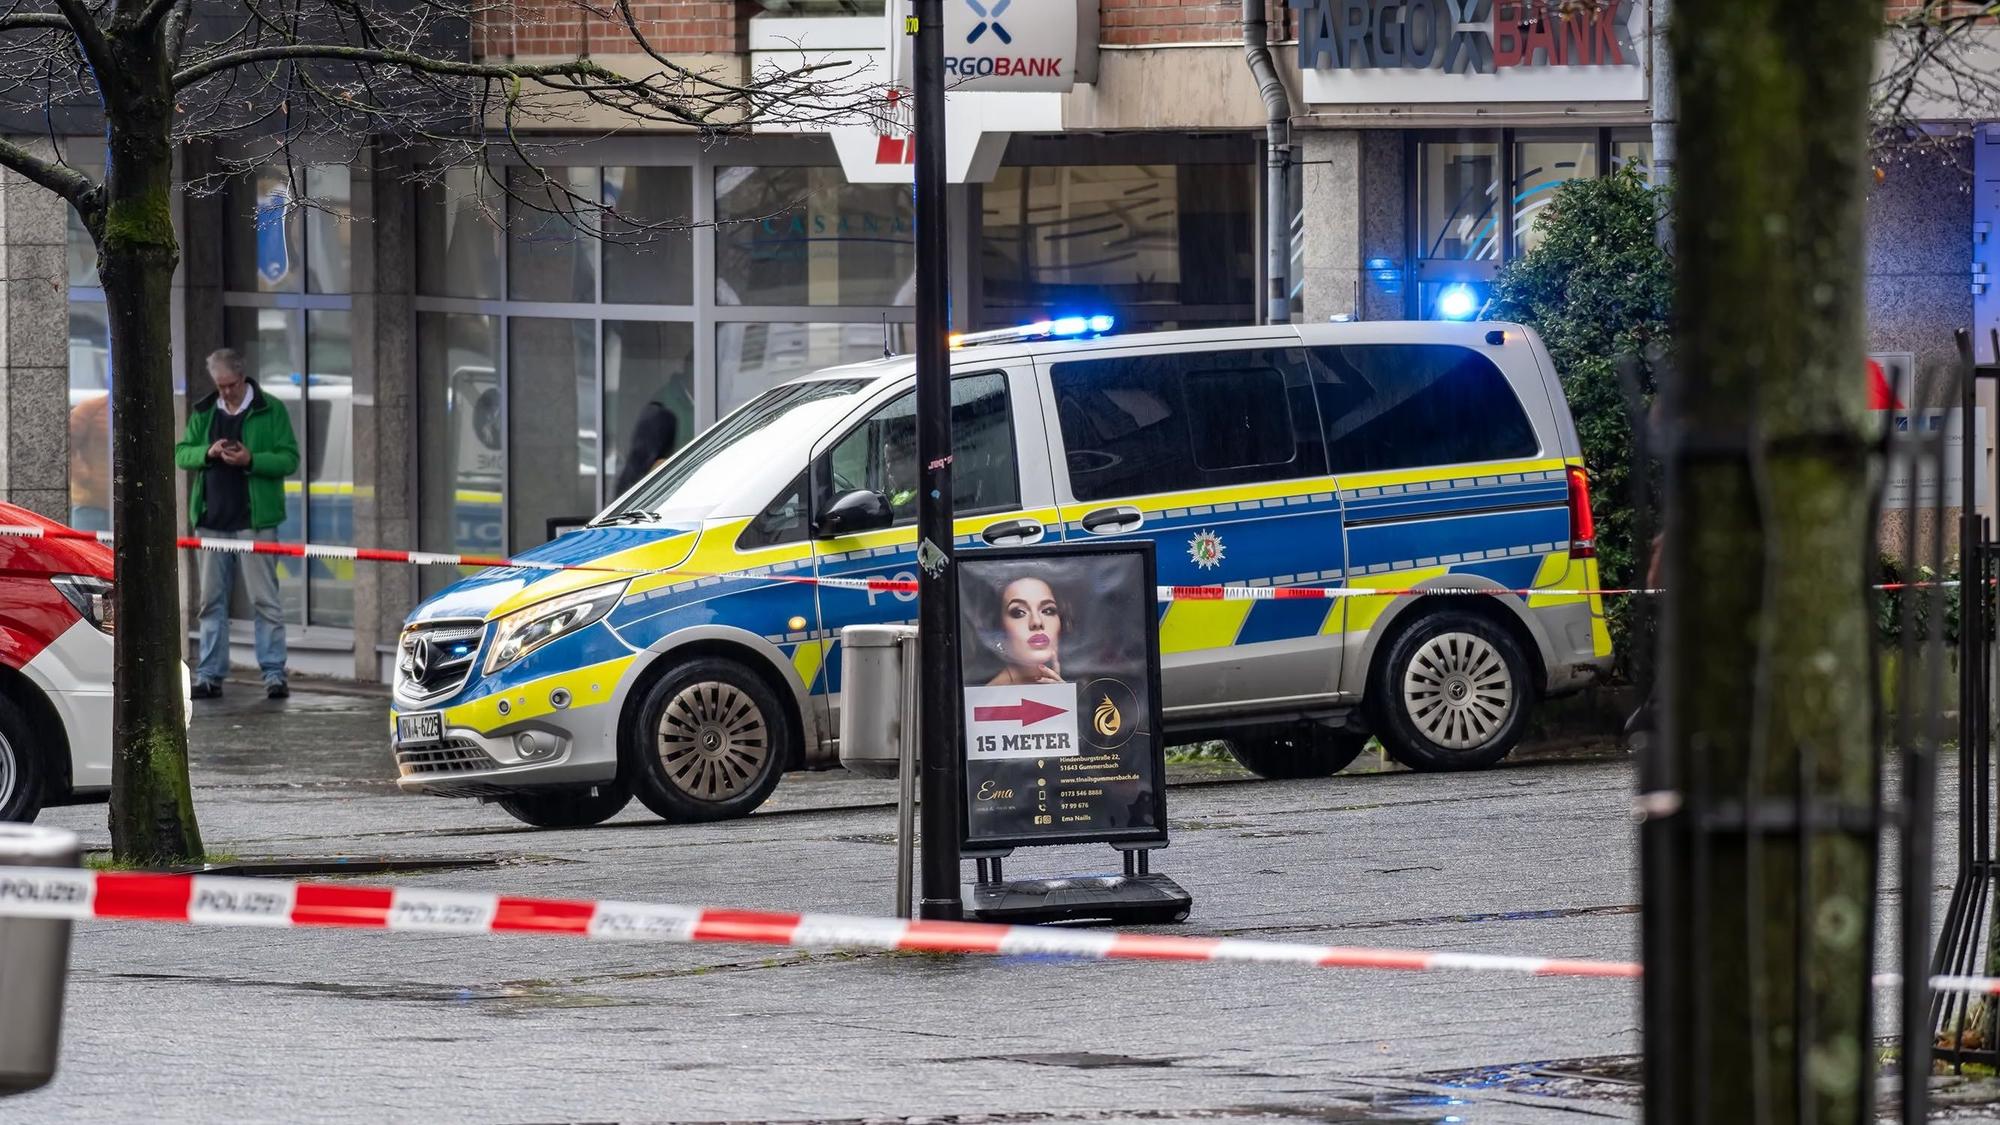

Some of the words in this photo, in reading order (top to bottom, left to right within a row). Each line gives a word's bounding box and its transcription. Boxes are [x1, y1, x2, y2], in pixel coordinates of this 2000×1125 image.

[1288, 0, 1437, 69] TARGO
[1493, 0, 1626, 67] BANK
[944, 57, 1062, 77] RGOBANK
[866, 571, 919, 606] PO
[976, 736, 996, 752] 15
[1002, 733, 1070, 752] METER
[1060, 754, 1111, 763] Hindenburgstraße
[1060, 764, 1078, 772] 51643
[1079, 762, 1119, 771] Gummersbach
[976, 780, 1014, 801] Ema
[1060, 790, 1075, 798] 0173
[1076, 789, 1087, 797] 546
[1060, 802, 1069, 810] 97
[1078, 801, 1089, 809] 676
[1, 877, 87, 904] POLIZEI
[200, 889, 288, 914] POLIZEI
